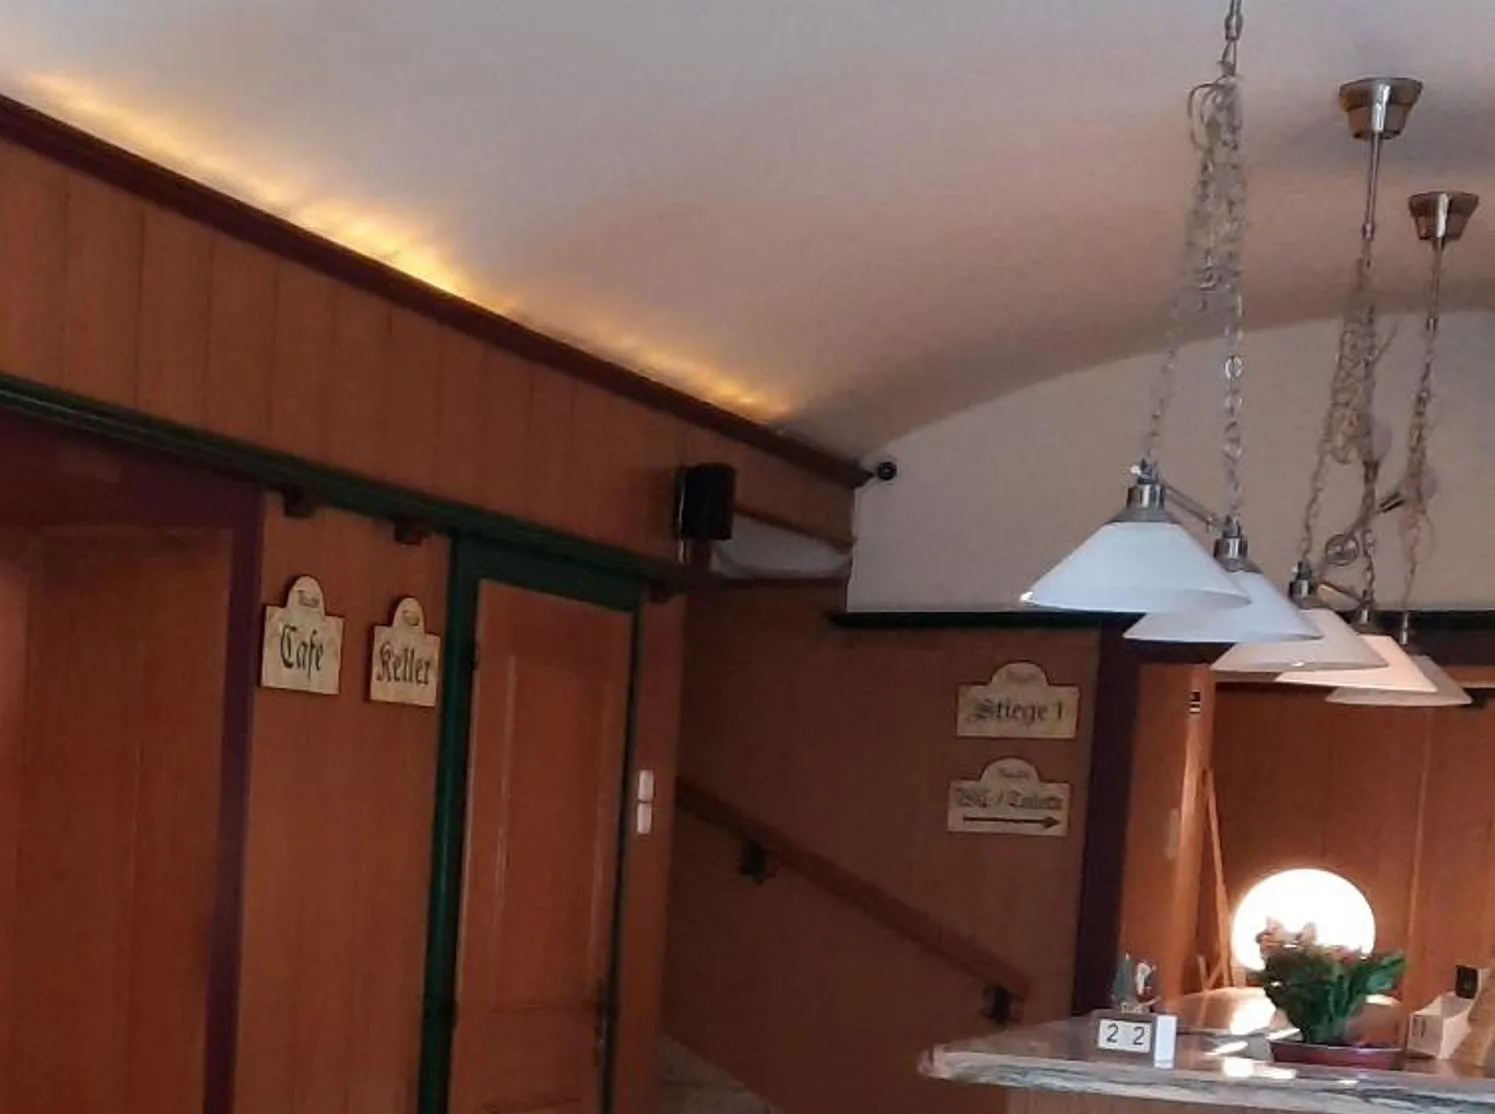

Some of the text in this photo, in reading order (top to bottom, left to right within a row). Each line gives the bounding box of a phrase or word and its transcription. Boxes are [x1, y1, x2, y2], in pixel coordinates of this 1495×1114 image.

[280, 623, 325, 681] Cafe
[376, 641, 431, 685] Keller
[968, 696, 1048, 726] Stiege
